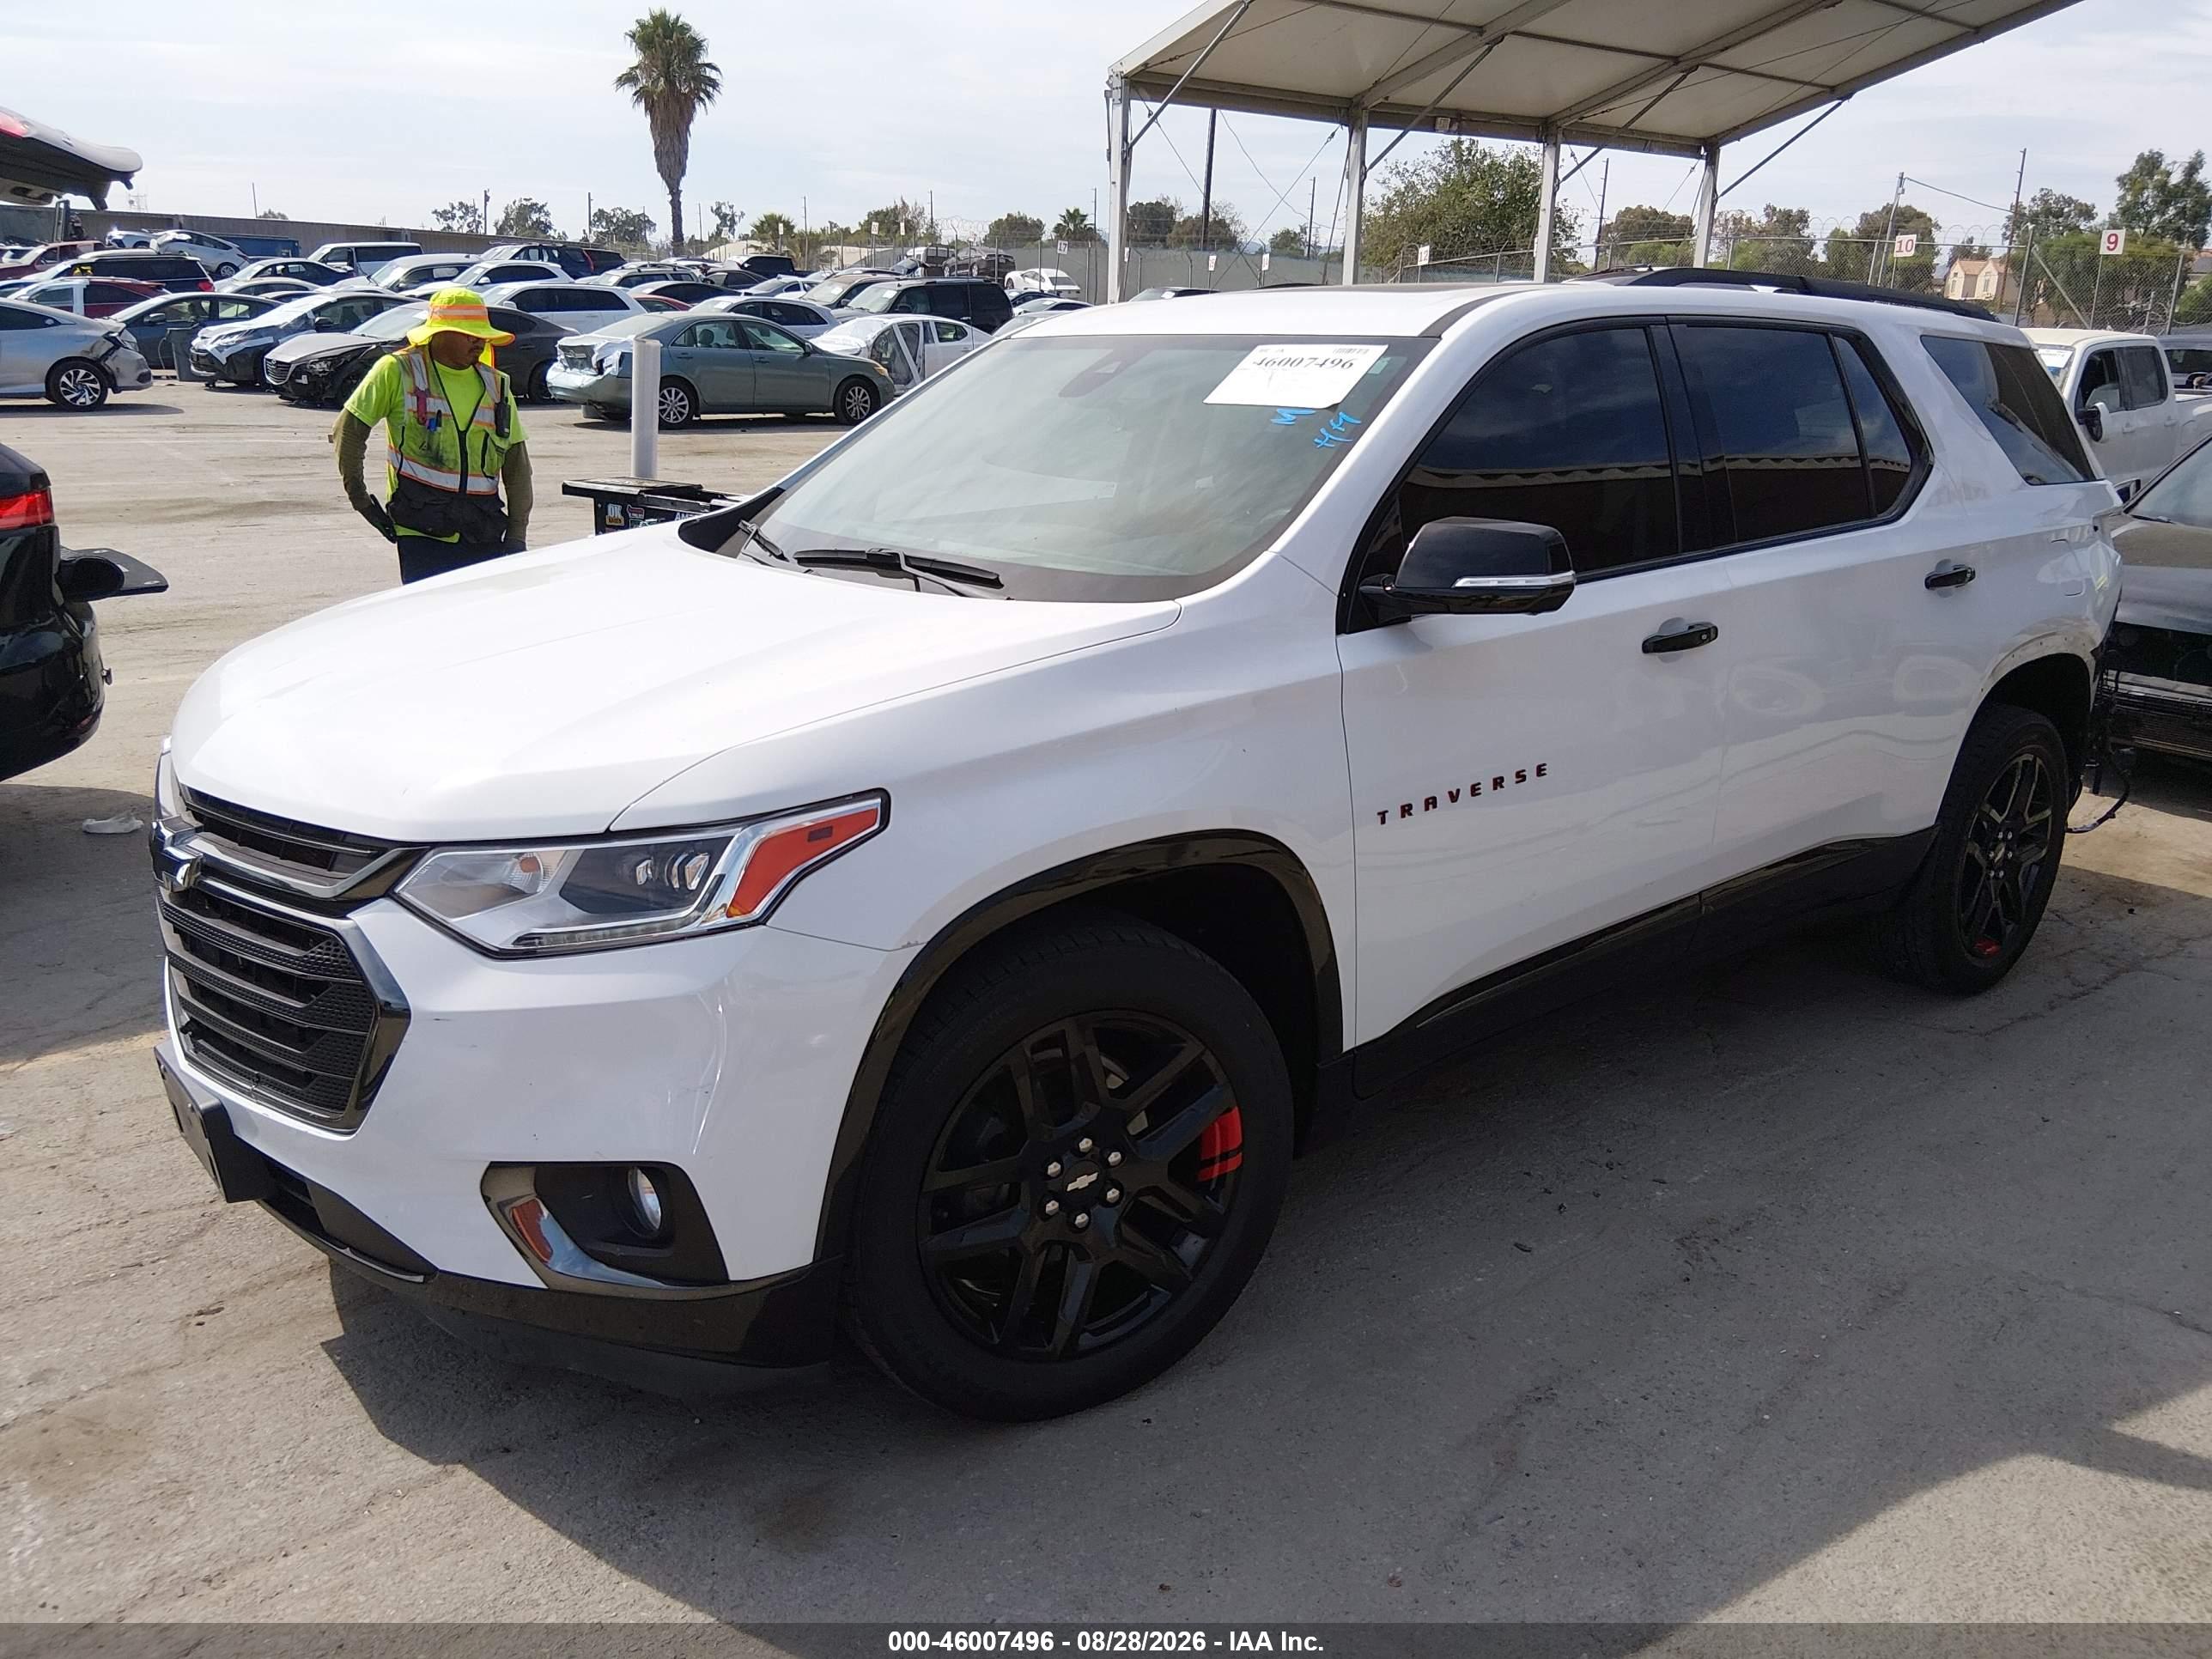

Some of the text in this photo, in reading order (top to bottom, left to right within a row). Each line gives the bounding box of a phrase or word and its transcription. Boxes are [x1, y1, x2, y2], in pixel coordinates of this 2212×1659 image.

[1059, 241, 1067, 252] 17
[1894, 238, 1915, 254] 10
[2106, 233, 2119, 252] 9
[1419, 250, 1428, 262] 12
[1252, 356, 1358, 370] 46007496
[1376, 763, 1547, 825] TRAVERSE
